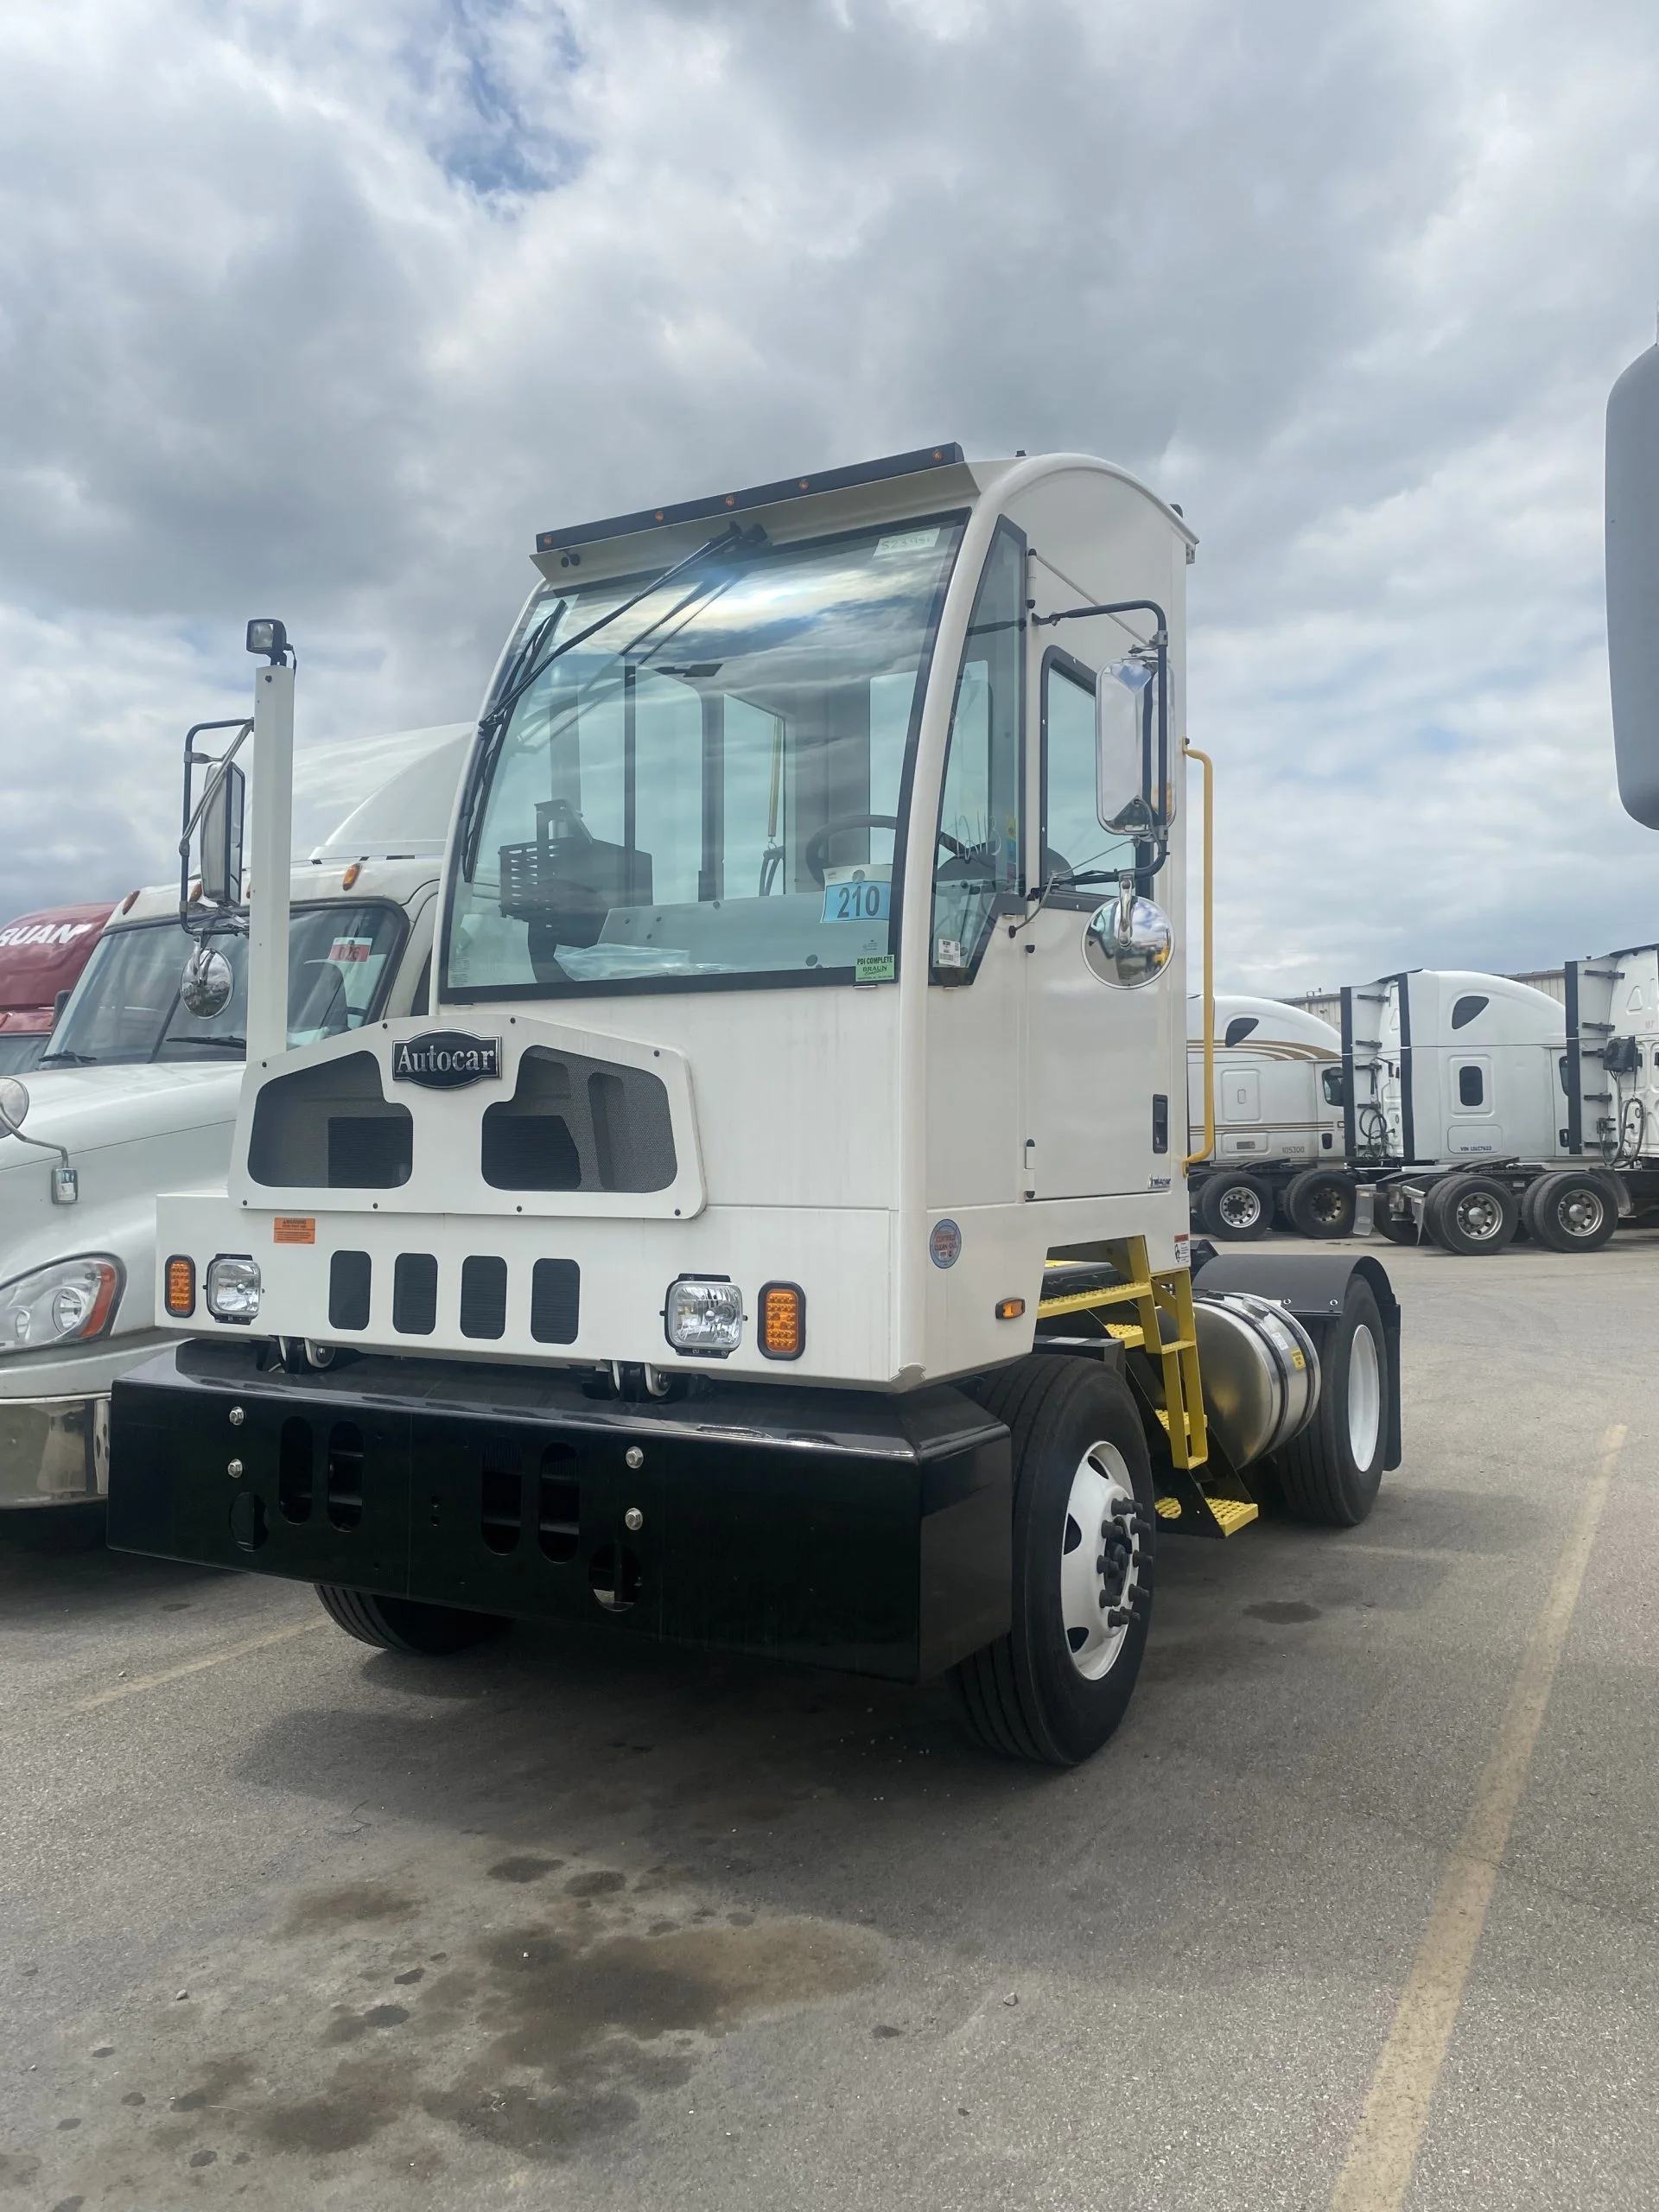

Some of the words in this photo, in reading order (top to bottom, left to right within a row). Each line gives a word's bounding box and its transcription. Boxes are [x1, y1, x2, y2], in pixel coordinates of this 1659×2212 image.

[836, 885, 880, 918] 210
[866, 956, 893, 964] COMPLETE
[396, 1045, 494, 1073] Autocar
